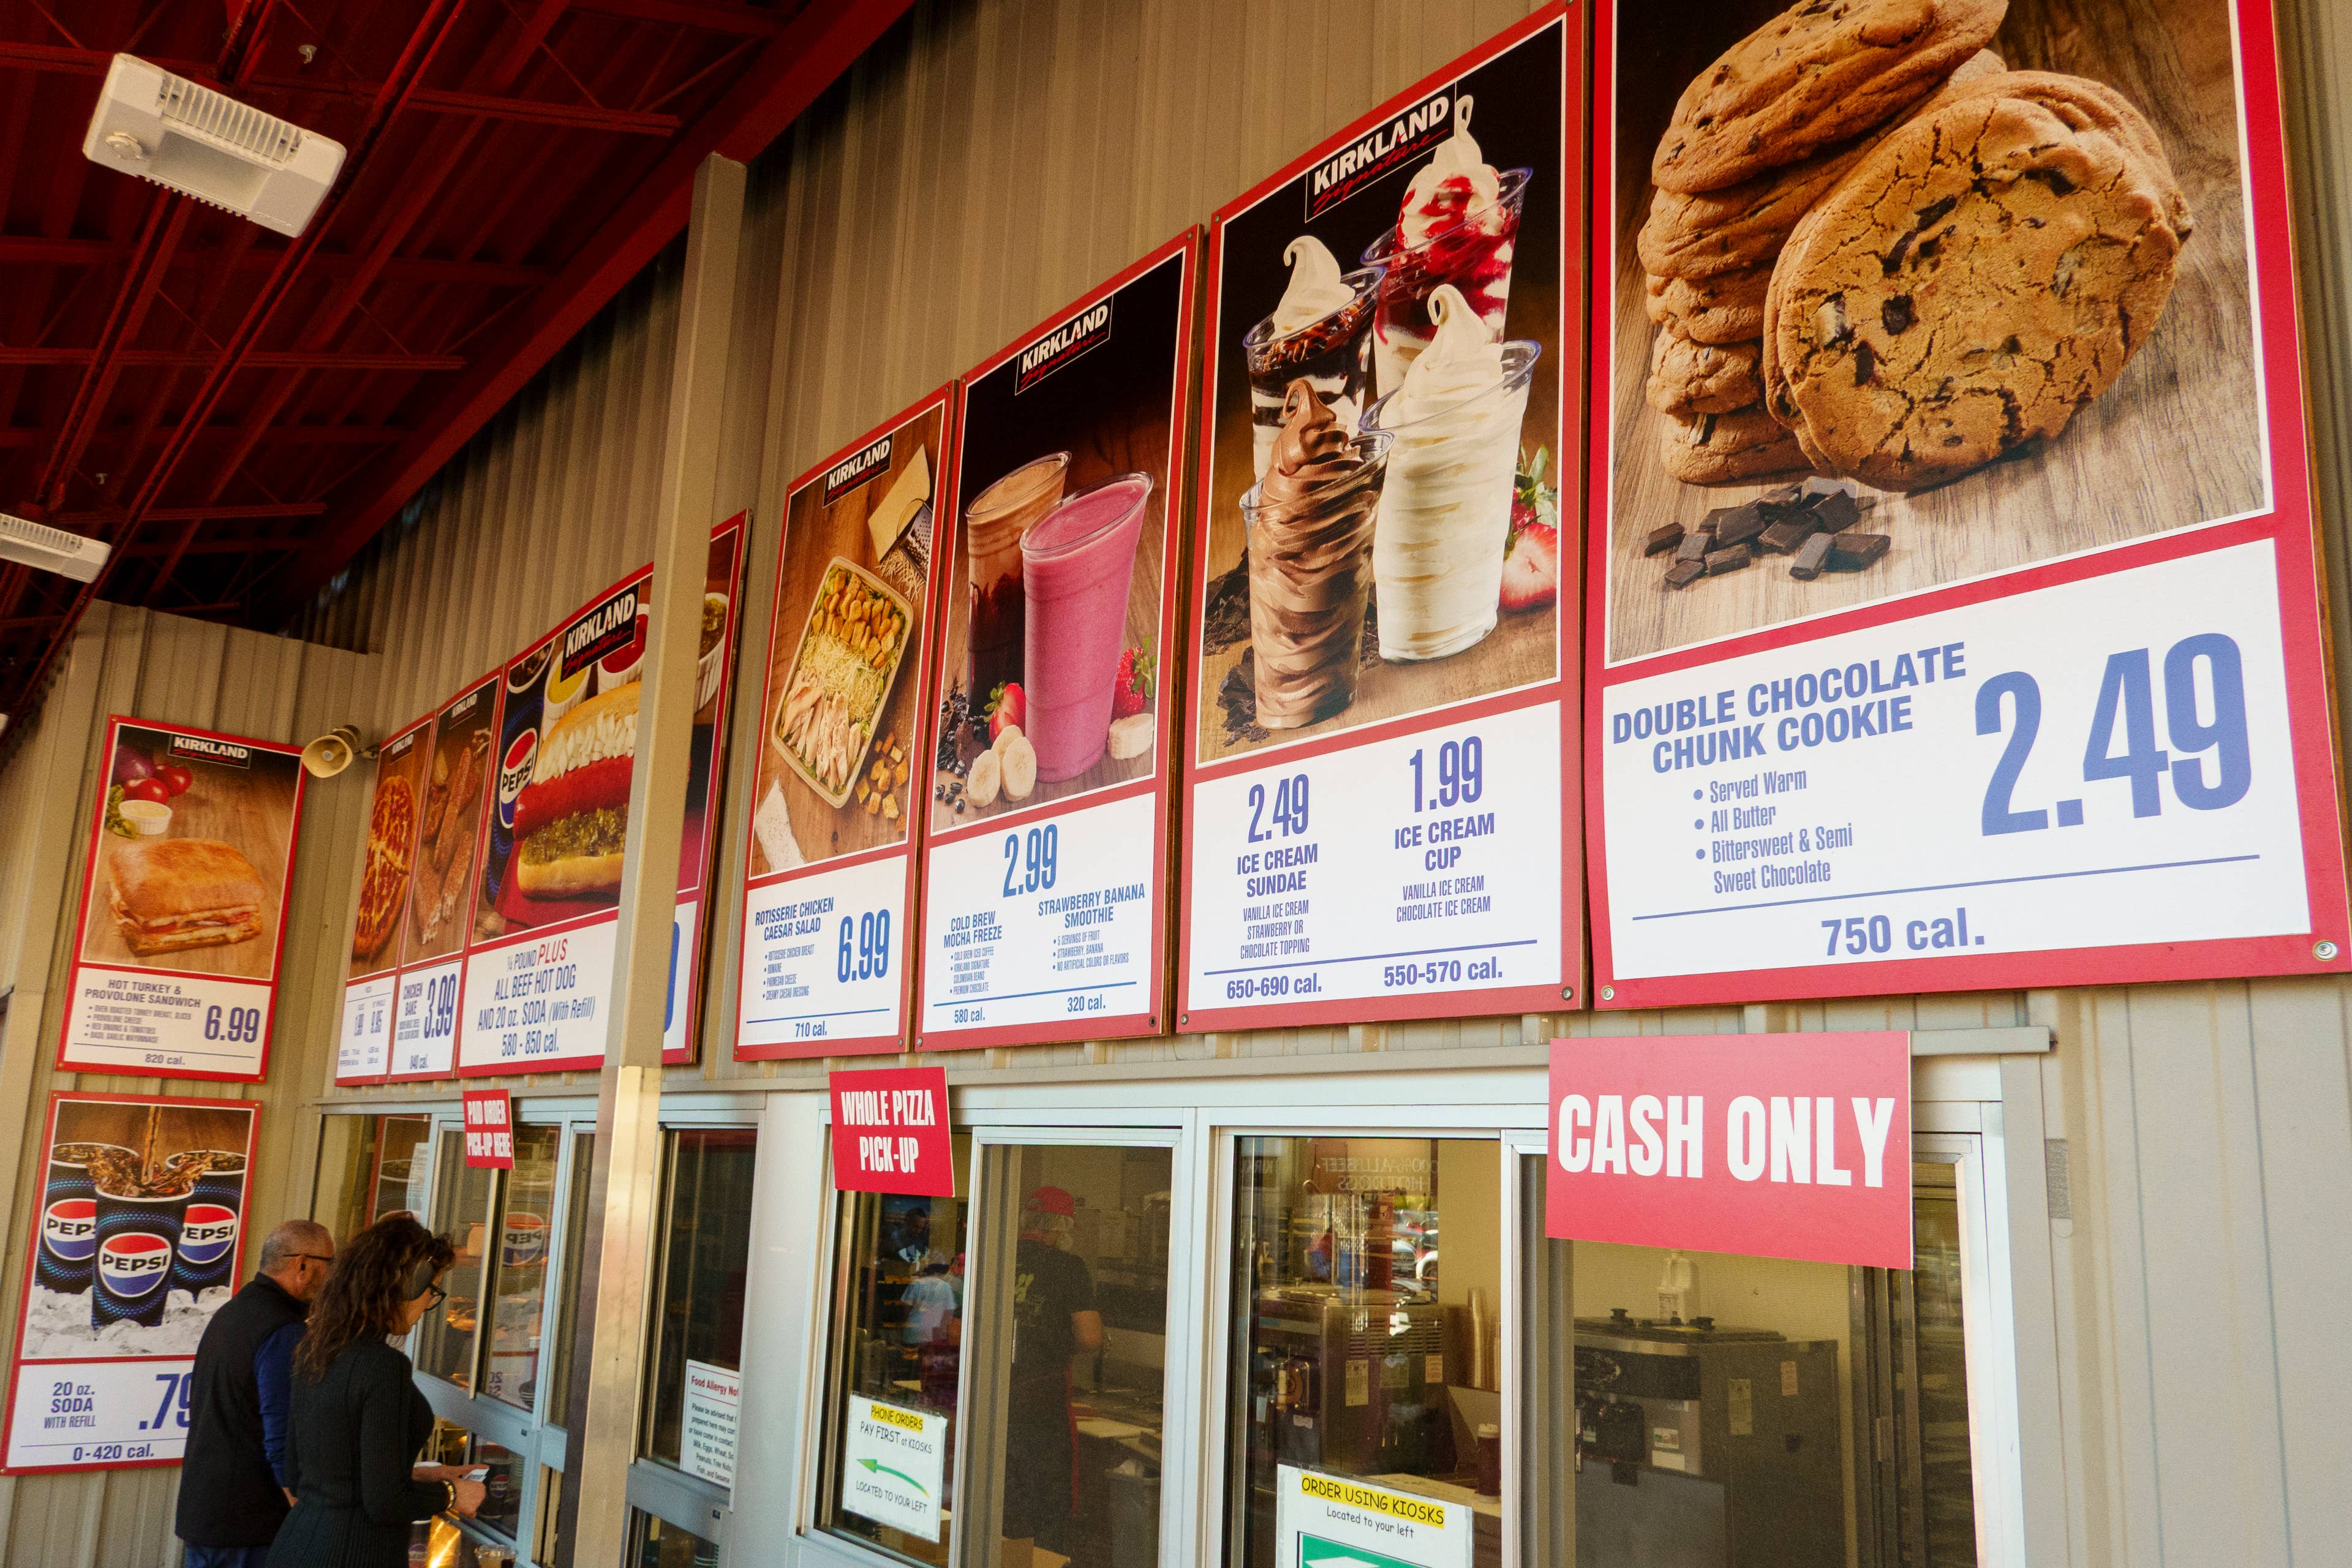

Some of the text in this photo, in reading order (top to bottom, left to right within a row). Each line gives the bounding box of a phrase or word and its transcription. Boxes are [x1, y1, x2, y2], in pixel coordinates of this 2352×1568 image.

[1314, 96, 1449, 195] KIRKLAND
[1313, 129, 1448, 214] Signature
[1022, 305, 1108, 374] KIRKLAND
[1020, 332, 1106, 390] Signature
[828, 440, 890, 490] KIRKLAND
[565, 593, 635, 658] KIRKLAND
[563, 630, 631, 678] Signature
[1613, 642, 1966, 744] DOUBLE CHOCOLATE
[174, 737, 247, 758] KIRKLAND
[1653, 696, 1913, 773] CHUNK COOKIE
[1975, 633, 2251, 836] 2.49
[1410, 736, 1483, 812] 1.99
[1709, 767, 1807, 804] Served Warm
[1248, 774, 1310, 843] 2.49
[1711, 804, 1776, 833] All Butter
[1395, 813, 1494, 849] ICE CREAM
[1712, 823, 1853, 864] Bittersweet & Semi
[1003, 824, 1058, 897] 2.99
[1237, 843, 1318, 875] ICE CREAM
[1425, 846, 1461, 871] CUP
[1246, 870, 1306, 897] SUNDAE
[1403, 875, 1484, 900] VANILLA ICE CREAM
[1714, 859, 1831, 894] Sweet Chocolate
[756, 897, 834, 926] ROTISSERIE CHICKEN
[1039, 883, 1145, 916] STRAWBERRY BANANA
[1243, 900, 1309, 922] VANILLA ICE CREAM
[1396, 896, 1490, 922] CHOCOLATE ICE CREAM
[764, 917, 821, 941] CAESAR SALAD
[951, 911, 995, 932] COLD BREW
[1065, 907, 1114, 928] SMOOTHIE
[1247, 921, 1303, 940] STRAWBERRY OR
[1821, 907, 1985, 957] 750 cal.
[838, 909, 890, 983] 6.99
[944, 925, 1002, 948] MOCHA FREEZE
[1058, 930, 1100, 945] 5 SERVINGS OF FRUIT
[1087, 943, 1103, 954] BANANA
[1240, 938, 1310, 959] CHOCOLATE TOPPING
[514, 939, 568, 970] POUND PLUS
[1057, 952, 1129, 971] NO ARTIFICIAL COLORS OR FLAVORS
[108, 979, 181, 995] HOT TURKEY &
[494, 964, 576, 1001] ALL BEEF HOT DOG
[1227, 973, 1322, 1000] 650-690 cal.
[1384, 956, 1502, 987] 550-570 cal.
[85, 989, 201, 1008] PROVOLONE SANDWICH
[424, 973, 456, 1038] 3.99
[478, 997, 595, 1031] AND 20 oz. SODA (With Refill)
[1068, 994, 1105, 1012] 320 cal.
[205, 1005, 260, 1042] 6.99
[796, 1020, 827, 1037] 710 cal.
[954, 1007, 985, 1023] 580 cal.
[502, 1033, 517, 1056] 580
[525, 1030, 542, 1054] 850
[544, 1028, 559, 1052] cal.
[145, 1054, 185, 1065] 820 cal.
[841, 1090, 935, 1126] WHOLE PIZZA
[859, 1136, 919, 1173] PICK-UP
[1558, 1094, 1895, 1188] CASH ONLY
[102, 1253, 167, 1272] PEPSI
[53, 1382, 94, 1396] 20 oz.
[692, 1375, 726, 1395] Food Allergy
[51, 1398, 92, 1412] SODA
[138, 1372, 193, 1430] .79
[44, 1415, 96, 1429] WITH REFILL
[872, 1405, 923, 1430] PHONE ORDERS
[127, 1444, 154, 1458] cal.
[861, 1421, 873, 1434] PAY
[876, 1426, 900, 1444] FIRST
[908, 1438, 932, 1454] KIOSKS
[856, 1480, 927, 1513] LOCATED TO YOUR LEFT
[1302, 1477, 1444, 1524] ORDER USING KIOSKS
[1327, 1506, 1414, 1539] Located to your left
